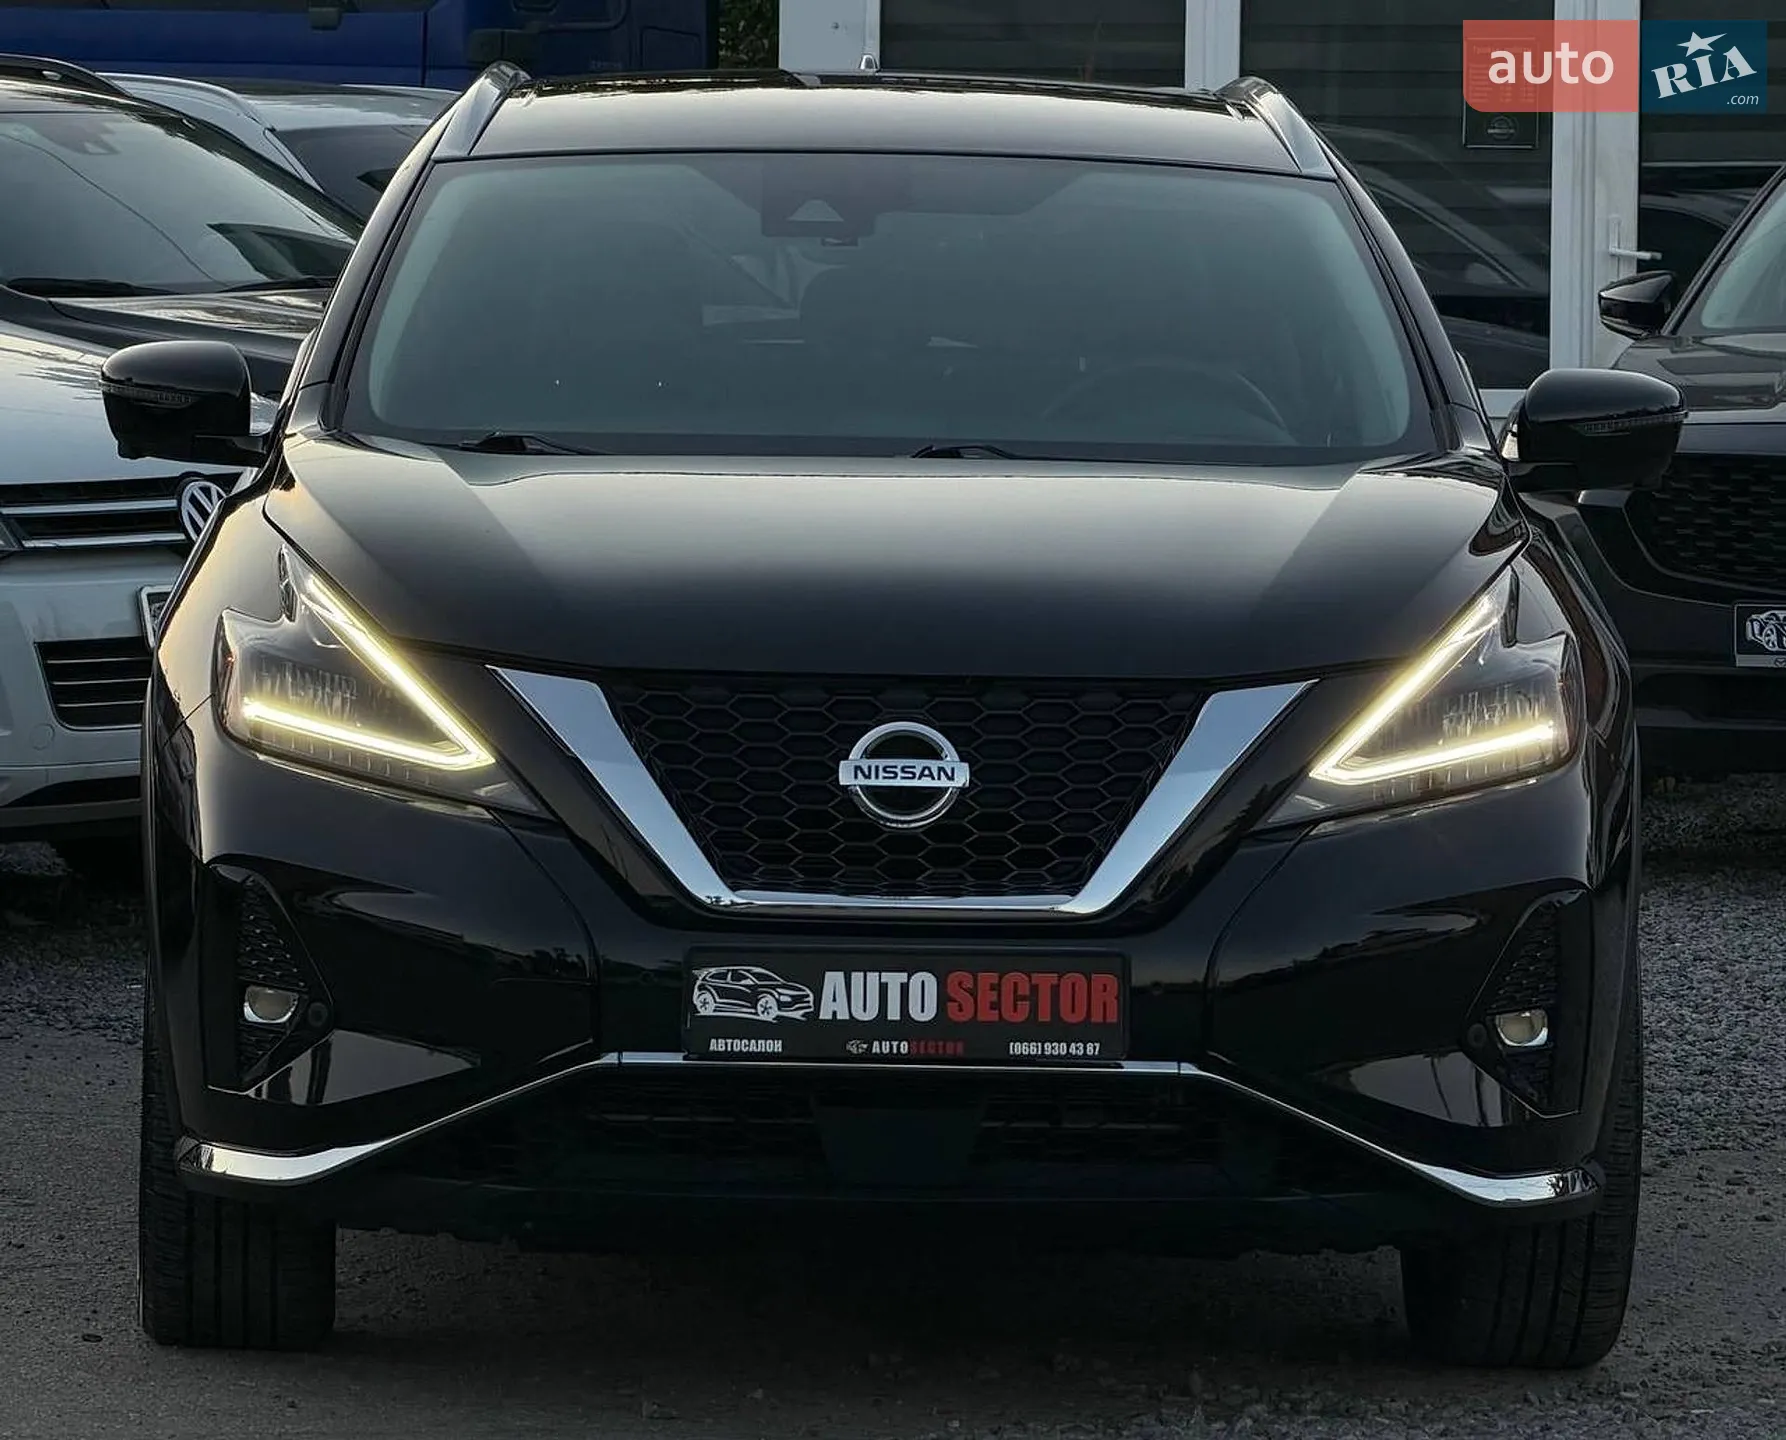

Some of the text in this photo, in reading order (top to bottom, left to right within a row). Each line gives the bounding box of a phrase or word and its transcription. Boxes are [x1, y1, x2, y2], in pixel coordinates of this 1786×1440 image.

[854, 765, 955, 781] NISSAN
[819, 971, 1118, 1023] AUTO SECTOR
[709, 1038, 783, 1052] АВТОСАЛОН
[1044, 1042, 1067, 1056] 930
[1069, 1042, 1084, 1056] 43
